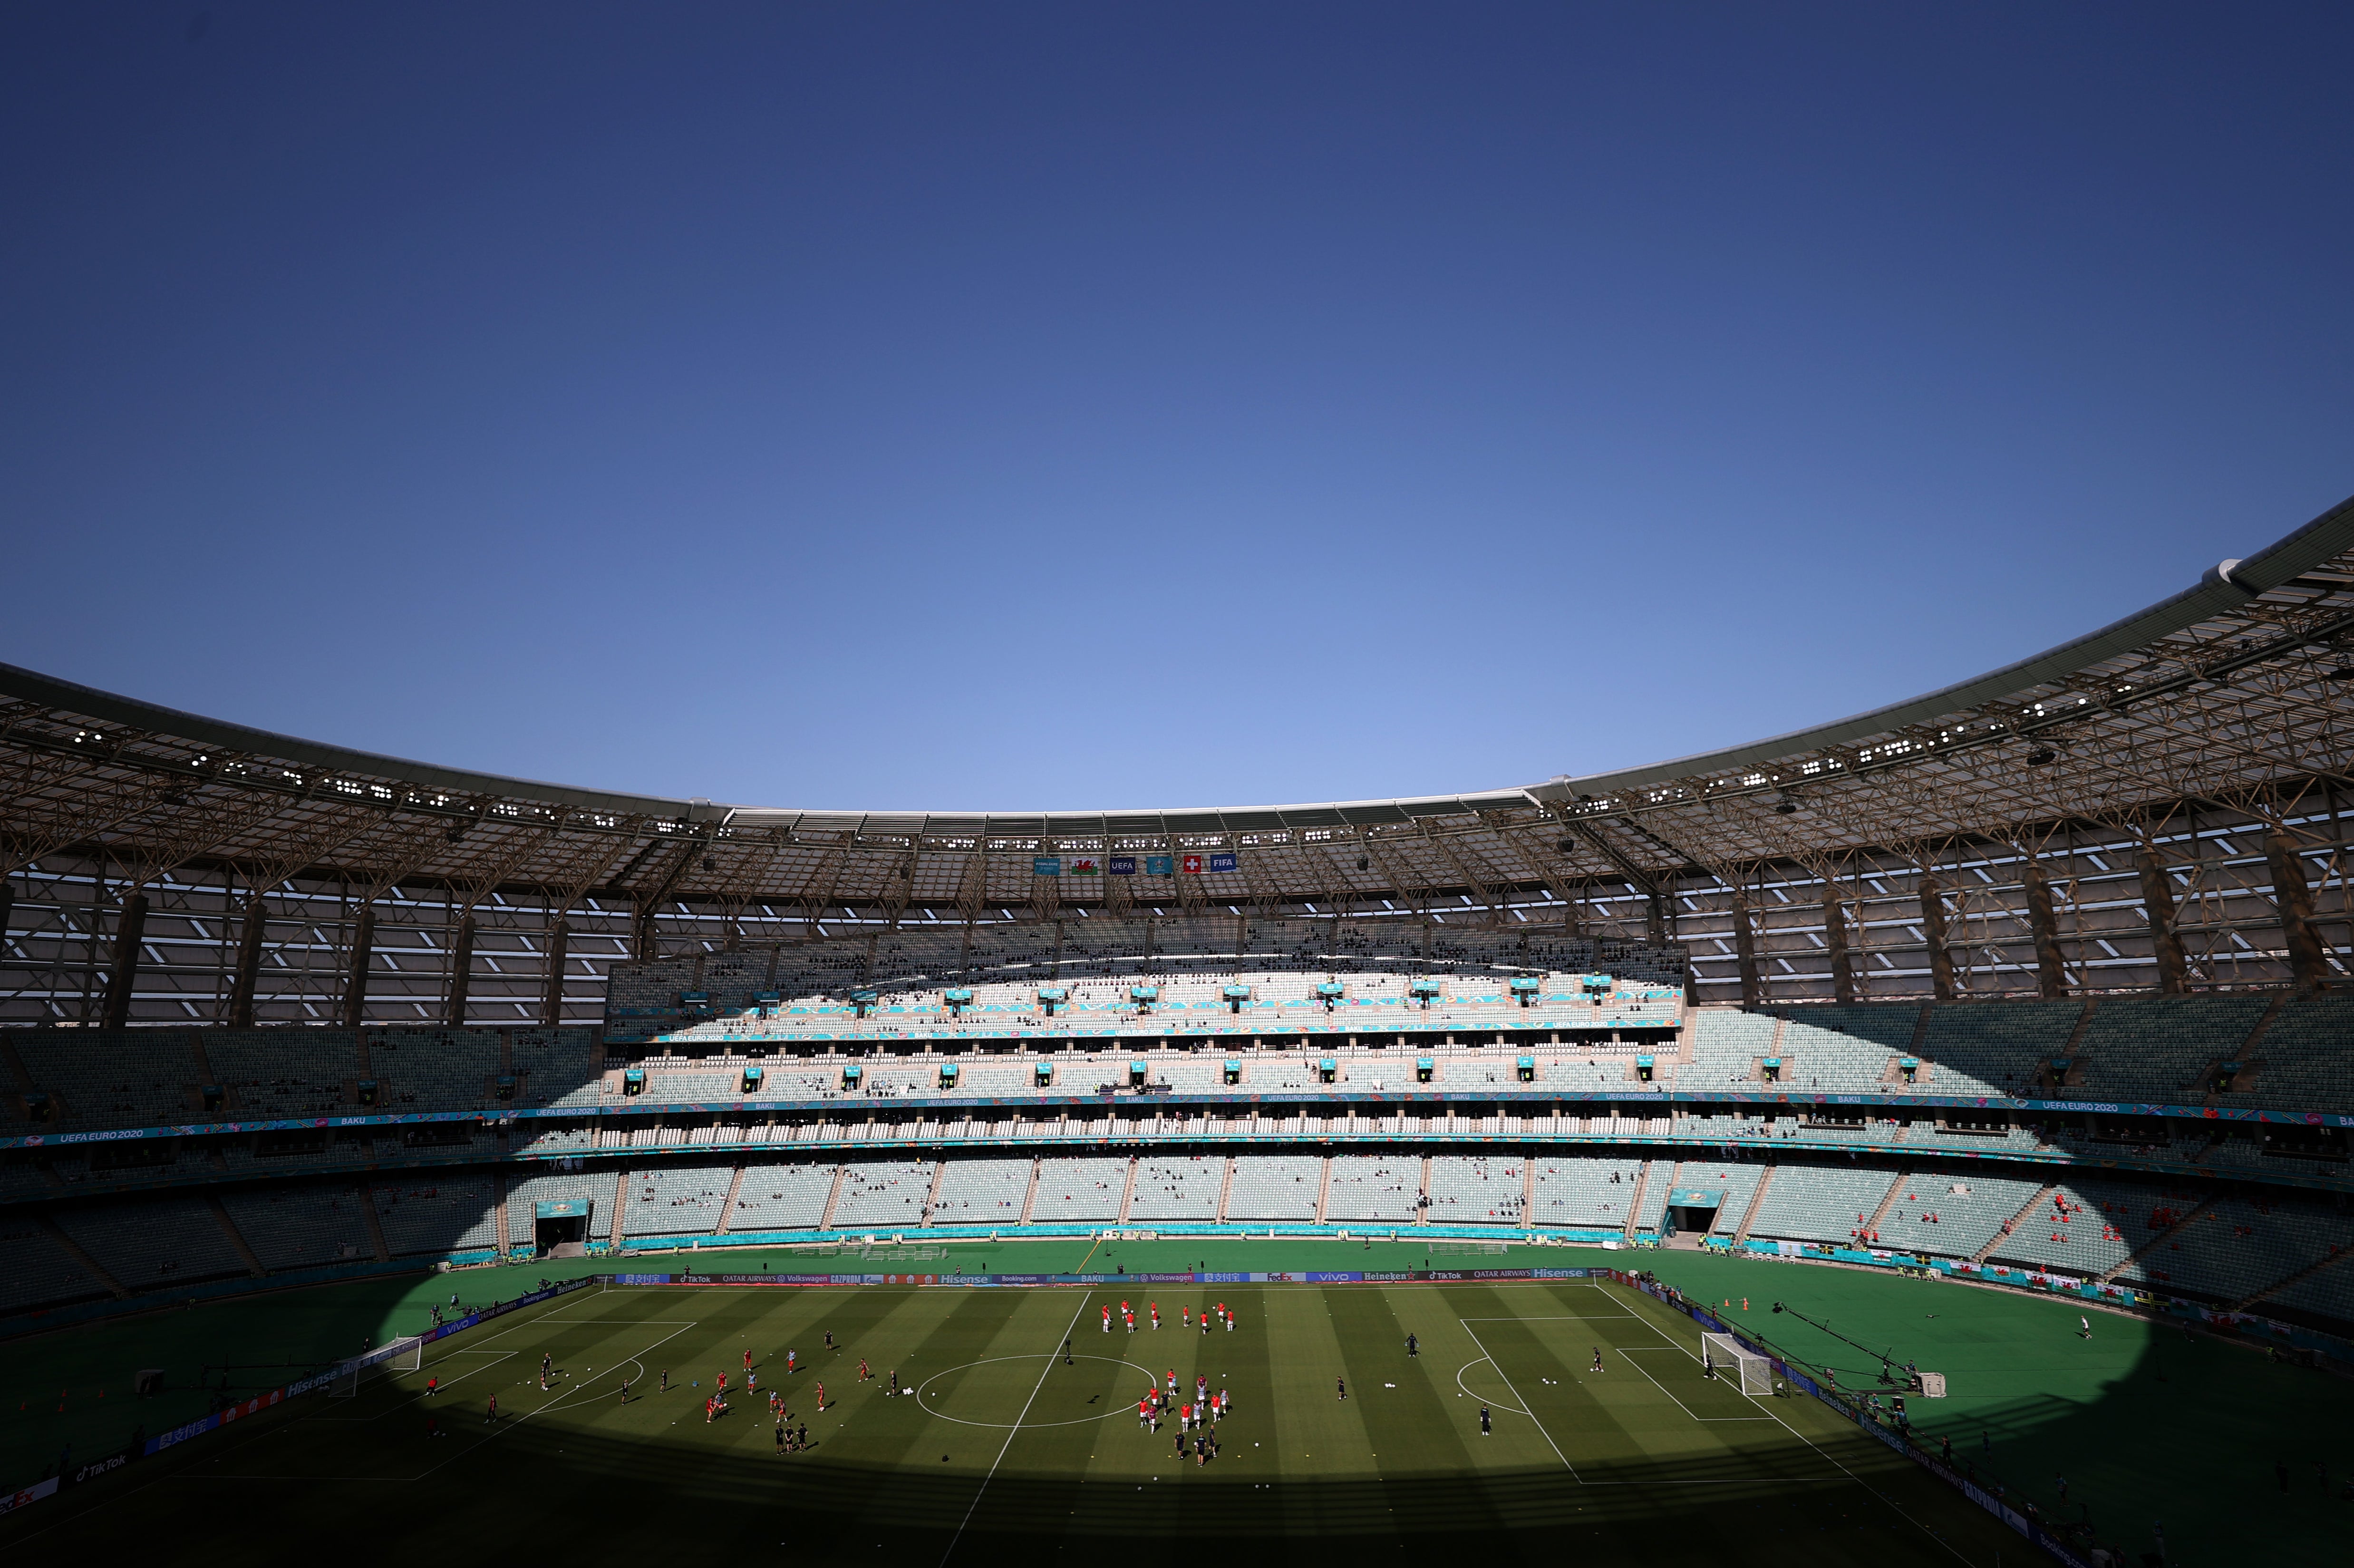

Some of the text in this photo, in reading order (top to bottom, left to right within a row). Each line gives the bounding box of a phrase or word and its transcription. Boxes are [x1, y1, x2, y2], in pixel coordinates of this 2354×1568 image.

[1214, 859, 1233, 867] FIFA
[2068, 1102, 2093, 1110] EURO
[2094, 1103, 2118, 1112] 2020
[60, 1130, 143, 1142] UEFA EURO 2020
[1150, 1274, 1192, 1283] Volkswagen
[1214, 1273, 1240, 1282] 支付宝
[1267, 1273, 1292, 1281] FedEx
[1319, 1272, 1348, 1280] vivo
[1364, 1272, 1406, 1280] Heineken
[1437, 1272, 1462, 1280] TikTok
[1534, 1268, 1583, 1278] Hisense
[635, 1275, 660, 1284] 支付宝
[688, 1275, 711, 1283] TikTok
[830, 1275, 861, 1284] GAZPROM
[940, 1275, 988, 1283] Hisense
[557, 1280, 587, 1295] Heineken
[523, 1291, 549, 1304] Booking.com
[478, 1301, 517, 1321] QATAR AIRWAYS
[447, 1319, 469, 1334] vivo
[1699, 1314, 1715, 1330] vivo
[287, 1370, 337, 1398] Hisense
[1818, 1388, 1850, 1417] Heineken
[173, 1419, 207, 1445] 支付宝
[1860, 1415, 1903, 1454] Hisense
[90, 1454, 126, 1478] TikTok
[1906, 1444, 1964, 1491] QATAR AIRWAYS
[1963, 1479, 2001, 1519] GAZPROM
